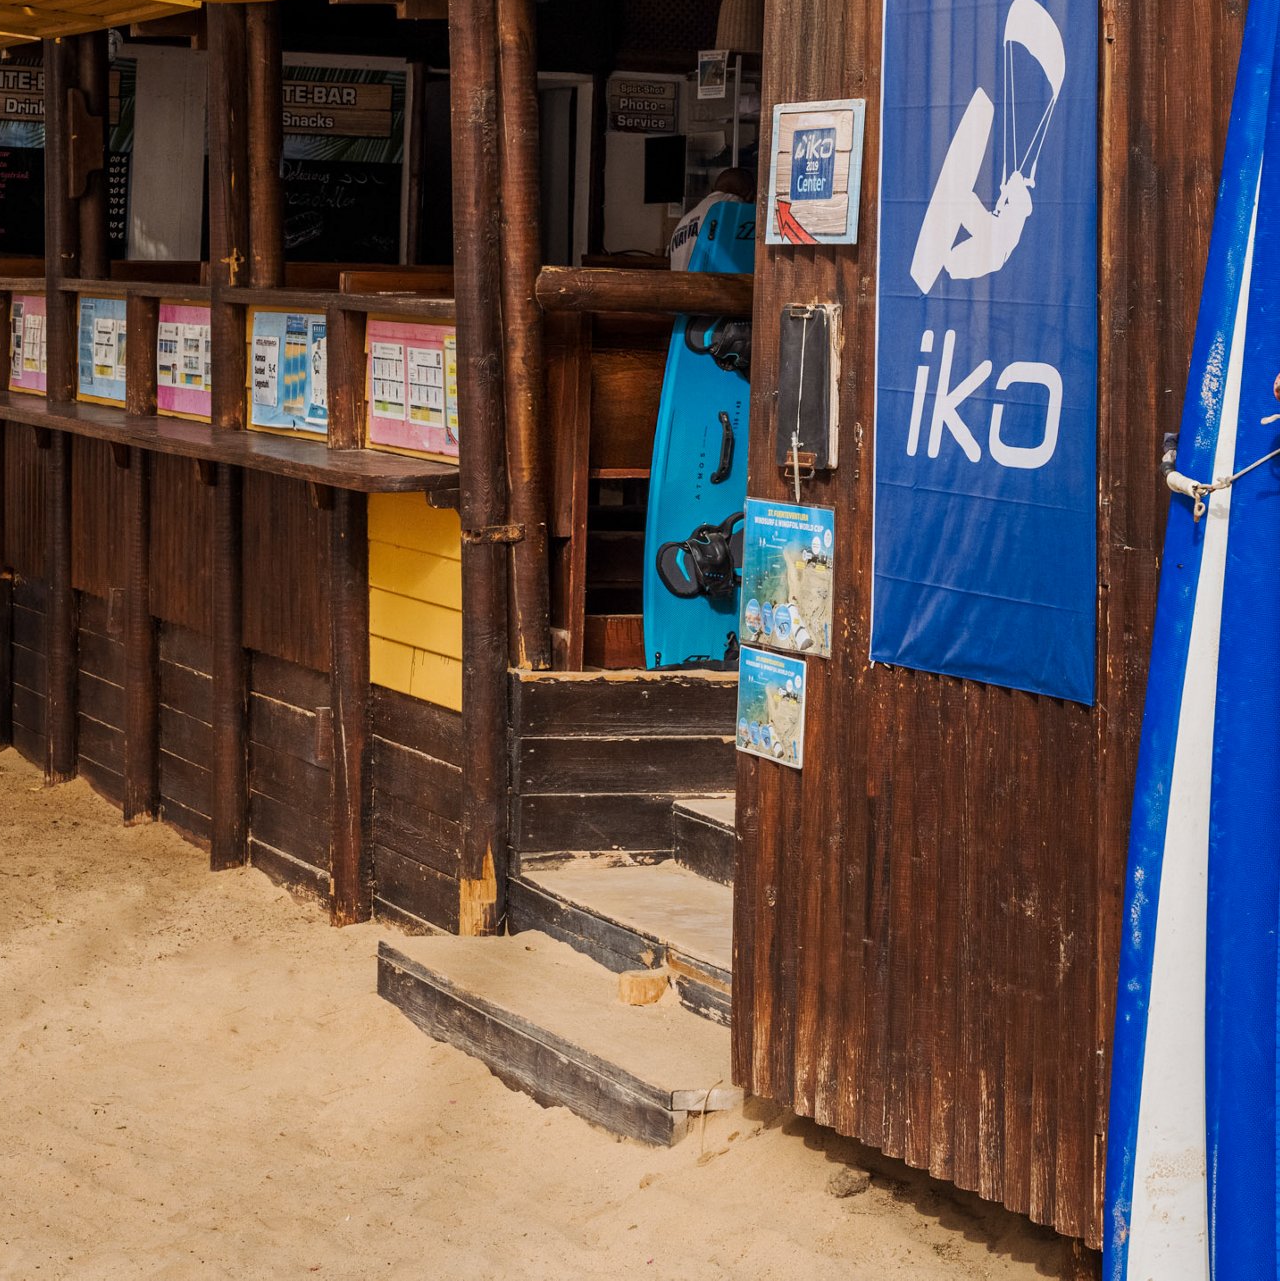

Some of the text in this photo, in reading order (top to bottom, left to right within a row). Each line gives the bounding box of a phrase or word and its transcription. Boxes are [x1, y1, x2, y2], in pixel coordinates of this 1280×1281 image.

[282, 111, 334, 128] Snacks
[617, 115, 665, 128] Service
[805, 134, 833, 158] iko
[797, 175, 827, 193] Center
[906, 328, 1063, 468] iko
[695, 452, 706, 500] ATMOS
